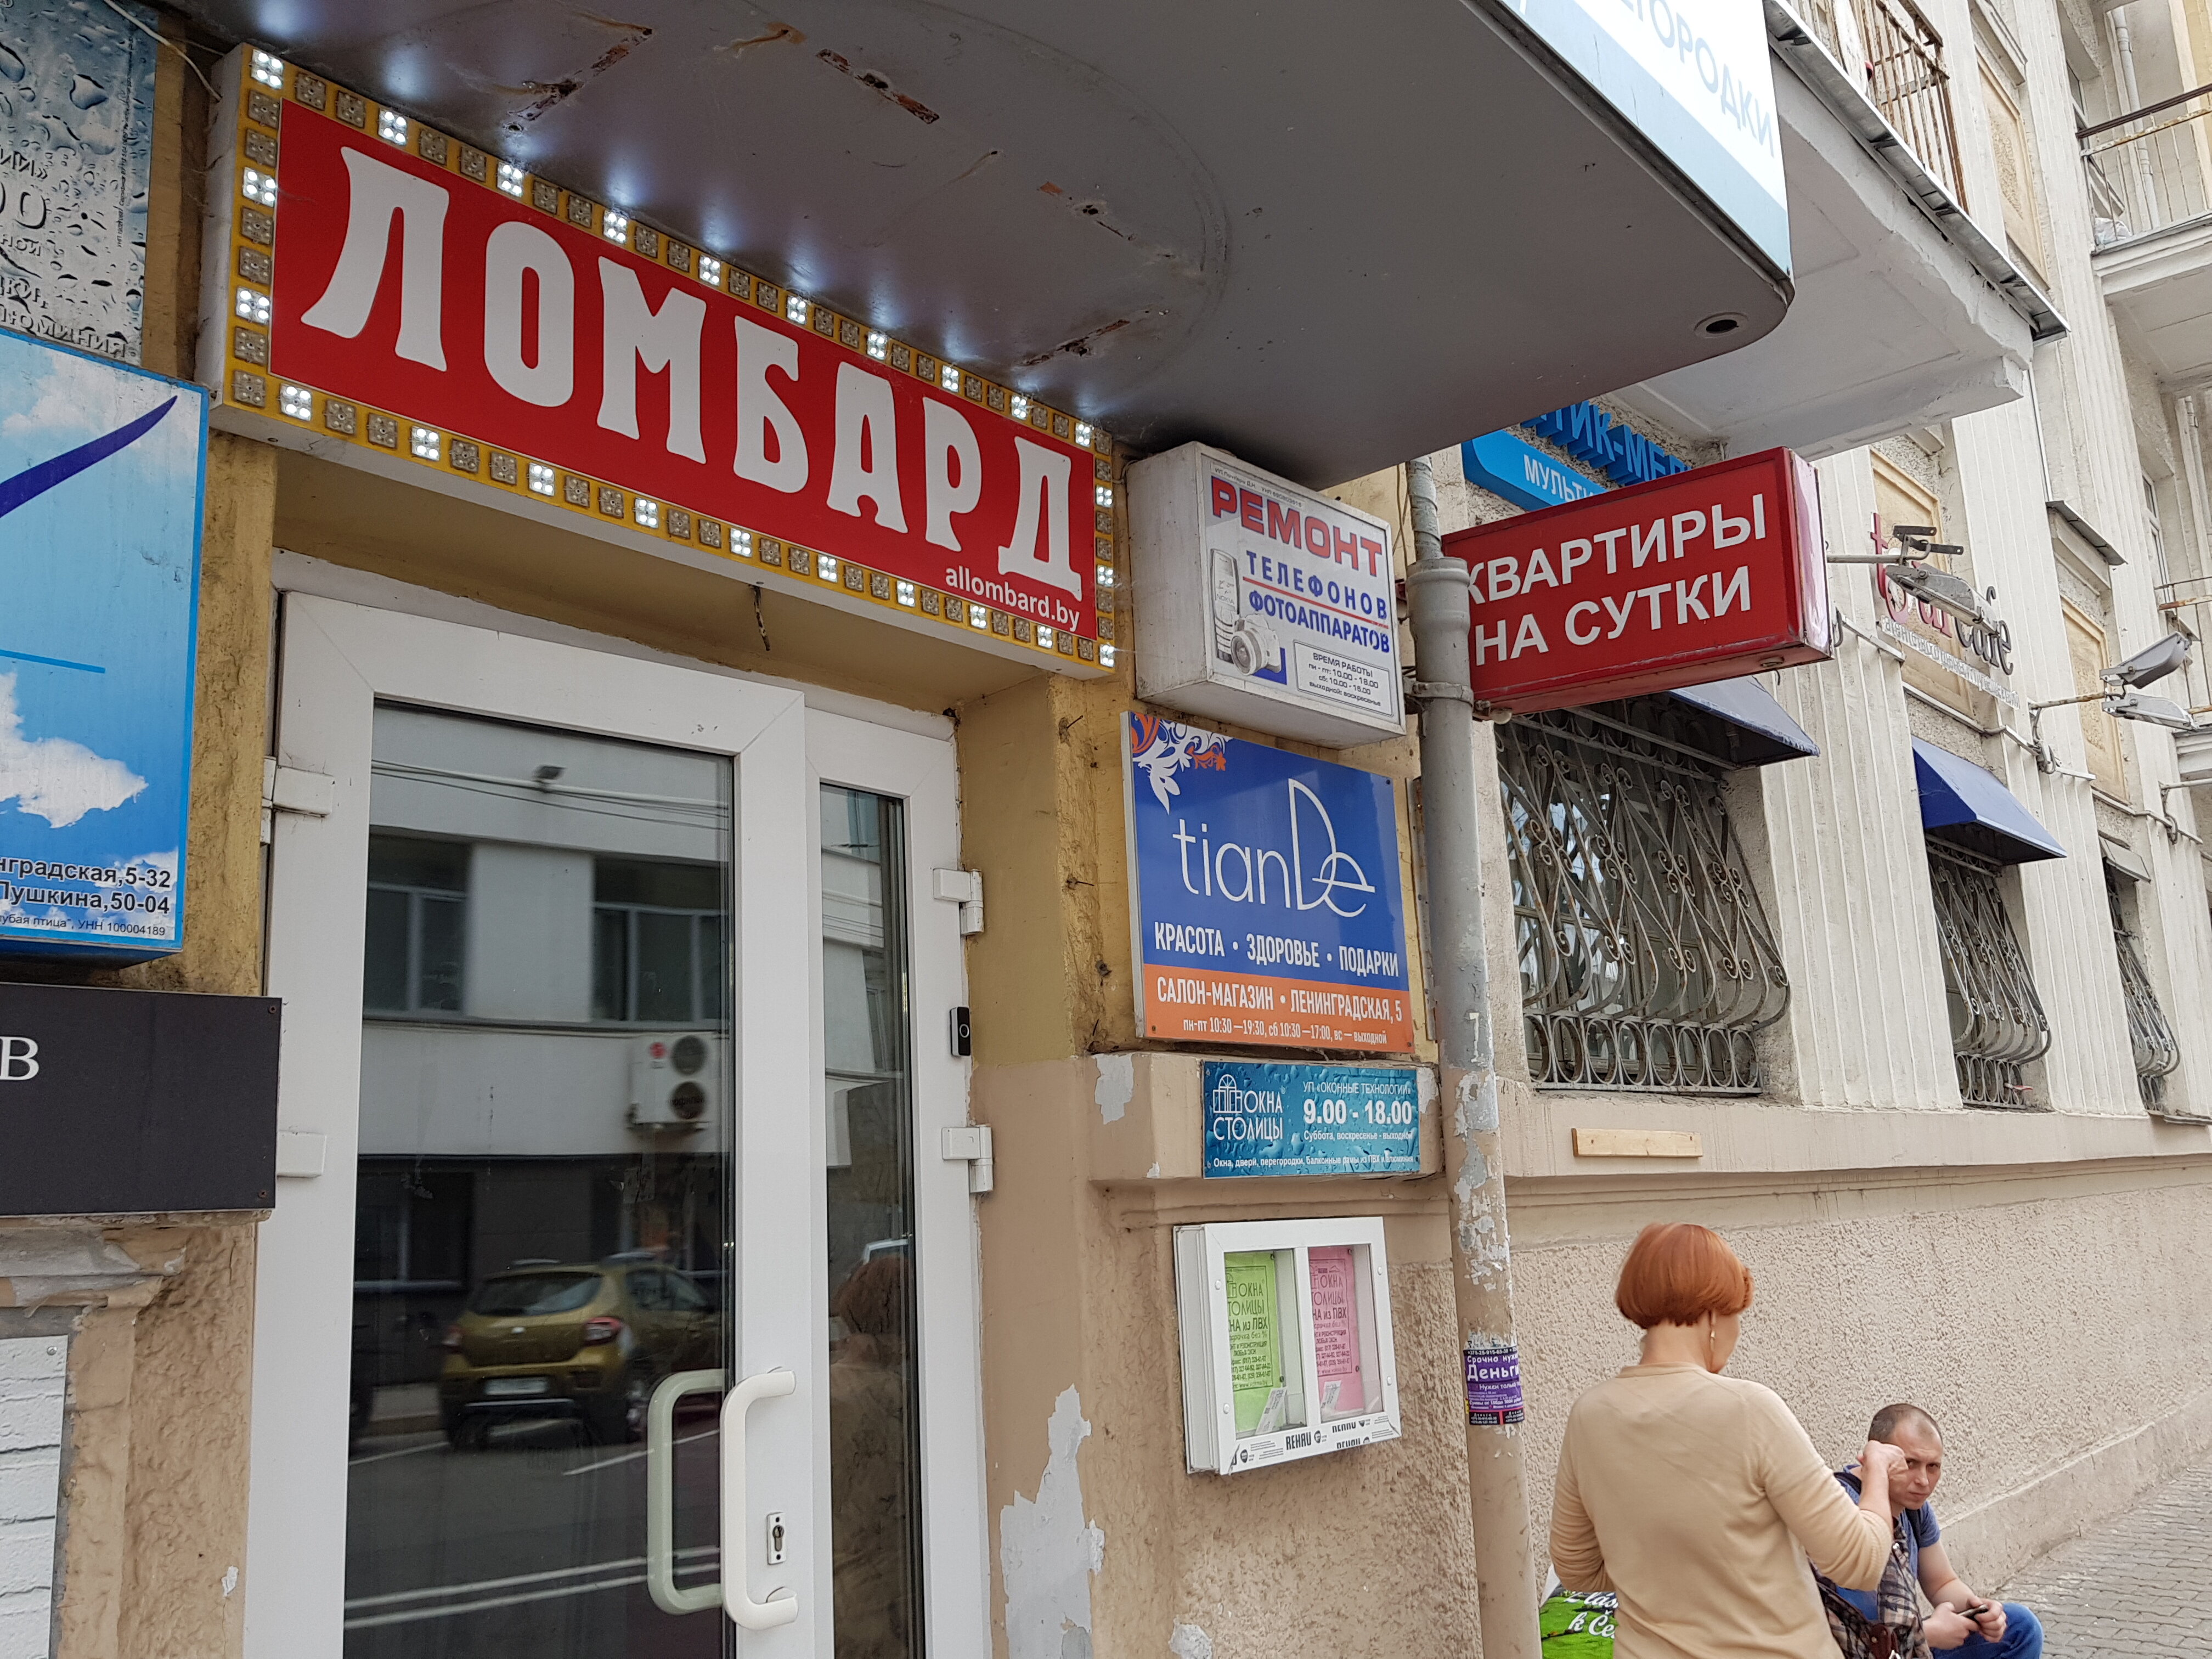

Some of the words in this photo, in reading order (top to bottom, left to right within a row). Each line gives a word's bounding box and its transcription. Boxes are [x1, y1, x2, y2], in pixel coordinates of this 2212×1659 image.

[1621, 0, 1775, 159] ОРОДКИ
[300, 146, 1082, 601] ЛОМБАРД
[1523, 454, 1594, 503] МУЛЬТ
[1211, 475, 1383, 577] РЕМОНТ
[1468, 493, 1766, 605] КВАРТИРЫ
[1246, 550, 1387, 620] ТЕЛЕФОНОВ
[946, 566, 1080, 631] allombard.by
[1564, 565, 1751, 646] СУТКИ
[1249, 590, 1390, 653] ФОТОАППАРАТОВ
[1475, 612, 1549, 666] НА
[1313, 652, 1340, 667] ВРЕМЯ
[1341, 662, 1373, 678] РАБОТЫ
[1329, 677, 1347, 688] 10.00
[1333, 669, 1353, 681] 10.00
[1359, 676, 1379, 689] 18.00
[1172, 778, 1376, 918] tianDe
[108, 923, 166, 936] 100004189
[1154, 921, 1226, 957] КРАСОТА
[1246, 933, 1321, 968] ЗДОРОВЬЕ
[1339, 945, 1399, 978] ПОДАРКИ
[1157, 976, 1274, 1011] САЛОН-МАГАЗИН
[1290, 989, 1393, 1024] ЛЕНИНГРАДСКАЯ,
[1395, 1000, 1403, 1022] 5
[1183, 1019, 1207, 1032] пн-пт
[1209, 1017, 1233, 1034] 10:30
[1268, 1022, 1278, 1037] сб
[1279, 1022, 1301, 1038] 10:30
[1334, 1030, 1343, 1041] вс
[1353, 1030, 1387, 1045] выходной
[1303, 1081, 1314, 1093] УП
[1316, 1081, 1359, 1094] «ОКОННЫЕ
[1361, 1082, 1412, 1095] ТЕХНОЛОГИИ»
[1244, 1090, 1283, 1114] ОКНА
[1304, 1098, 1347, 1125] 9.00
[1364, 1099, 1412, 1125] 18.00
[1213, 1116, 1283, 1142] СТОЛИЦЫ
[1304, 1129, 1336, 1142] Суббота,
[1337, 1131, 1378, 1143] воскресенье
[1383, 1131, 1413, 1141] выходной
[1214, 1158, 1234, 1168] Окна,
[1235, 1158, 1260, 1168] двери,
[1260, 1158, 1305, 1167] перегородки,
[1306, 1155, 1341, 1165] балконные
[1238, 1282, 1263, 1297] ОКНА
[1320, 1273, 1343, 1288] ОКНА
[1229, 1318, 1241, 1332] НА
[1242, 1321, 1251, 1331] из
[1252, 1316, 1268, 1330] ПВХ
[1323, 1311, 1331, 1320] из
[1333, 1307, 1347, 1319] ПВХ
[1467, 1355, 1499, 1365] Срочно
[1467, 1364, 1520, 1382] Деньги
[1285, 1431, 1312, 1451] REHAU
[1588, 1609, 1615, 1639] Če
